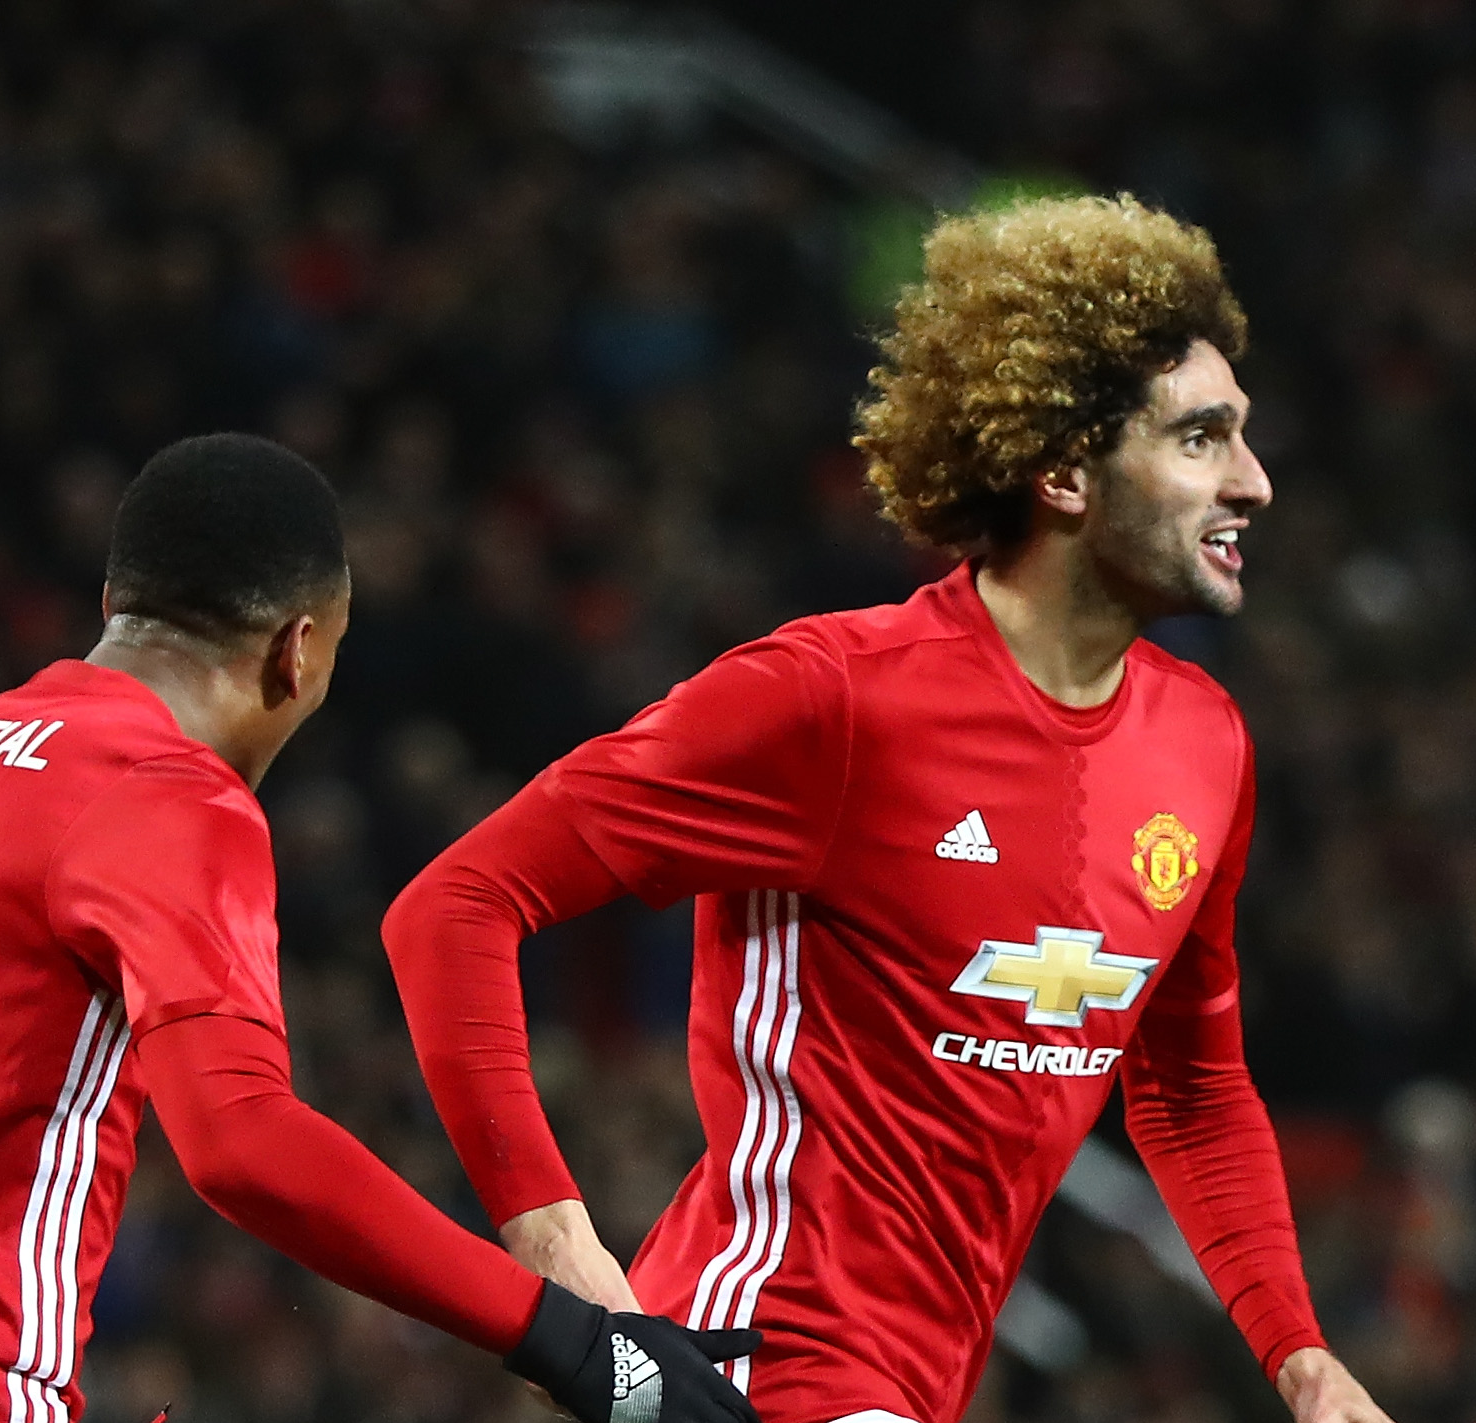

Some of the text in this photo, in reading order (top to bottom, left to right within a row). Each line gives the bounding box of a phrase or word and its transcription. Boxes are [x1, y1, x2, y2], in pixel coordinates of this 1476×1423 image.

[934, 841, 1000, 865] adidas
[931, 1031, 1124, 1077] CHEVROLET
[610, 1332, 632, 1399] adidas
